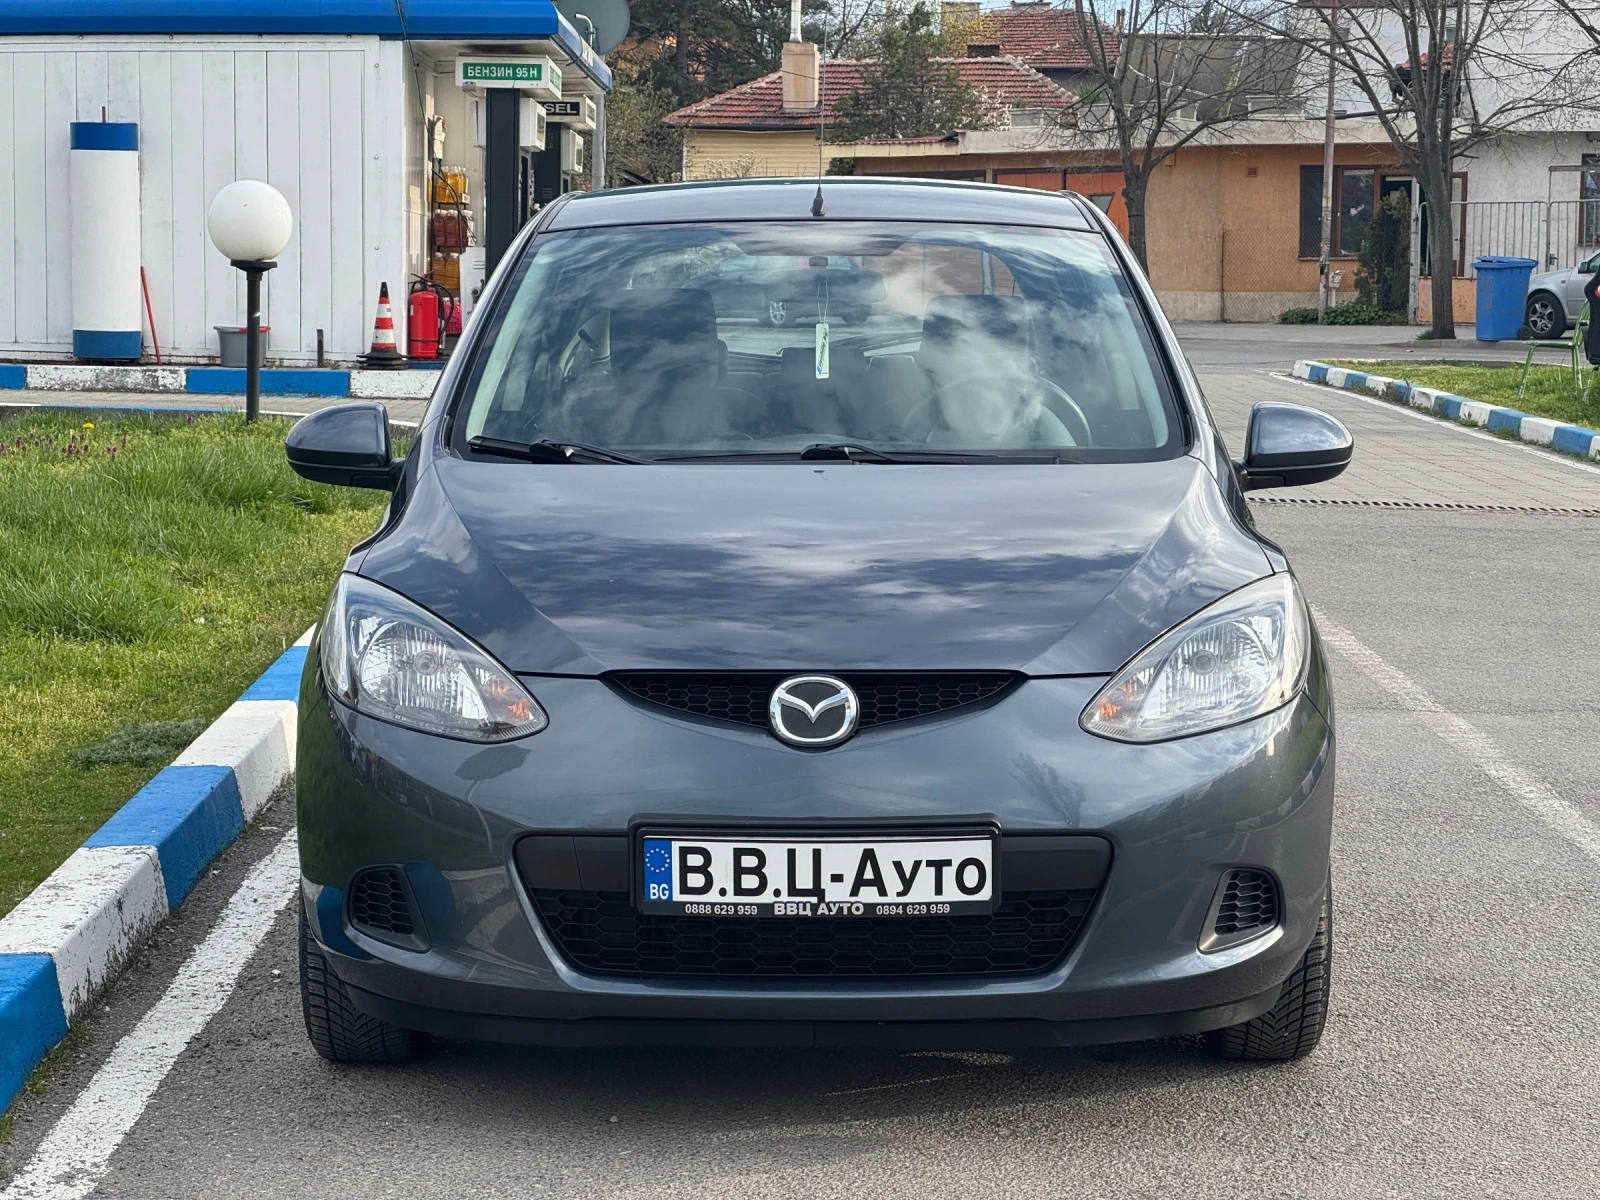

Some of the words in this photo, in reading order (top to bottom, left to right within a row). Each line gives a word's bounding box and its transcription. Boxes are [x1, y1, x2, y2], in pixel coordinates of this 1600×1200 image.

[467, 66, 513, 77] БЕНЗИН
[541, 103, 577, 113] SEL
[650, 884, 669, 899] BG
[685, 904, 711, 914] 0888
[714, 905, 734, 915] 629
[737, 905, 758, 915] 959
[774, 903, 811, 916] ВВЦ
[817, 903, 864, 915] АУТО
[876, 905, 903, 915] 0894
[906, 905, 927, 914] 629
[930, 904, 950, 914] 959
